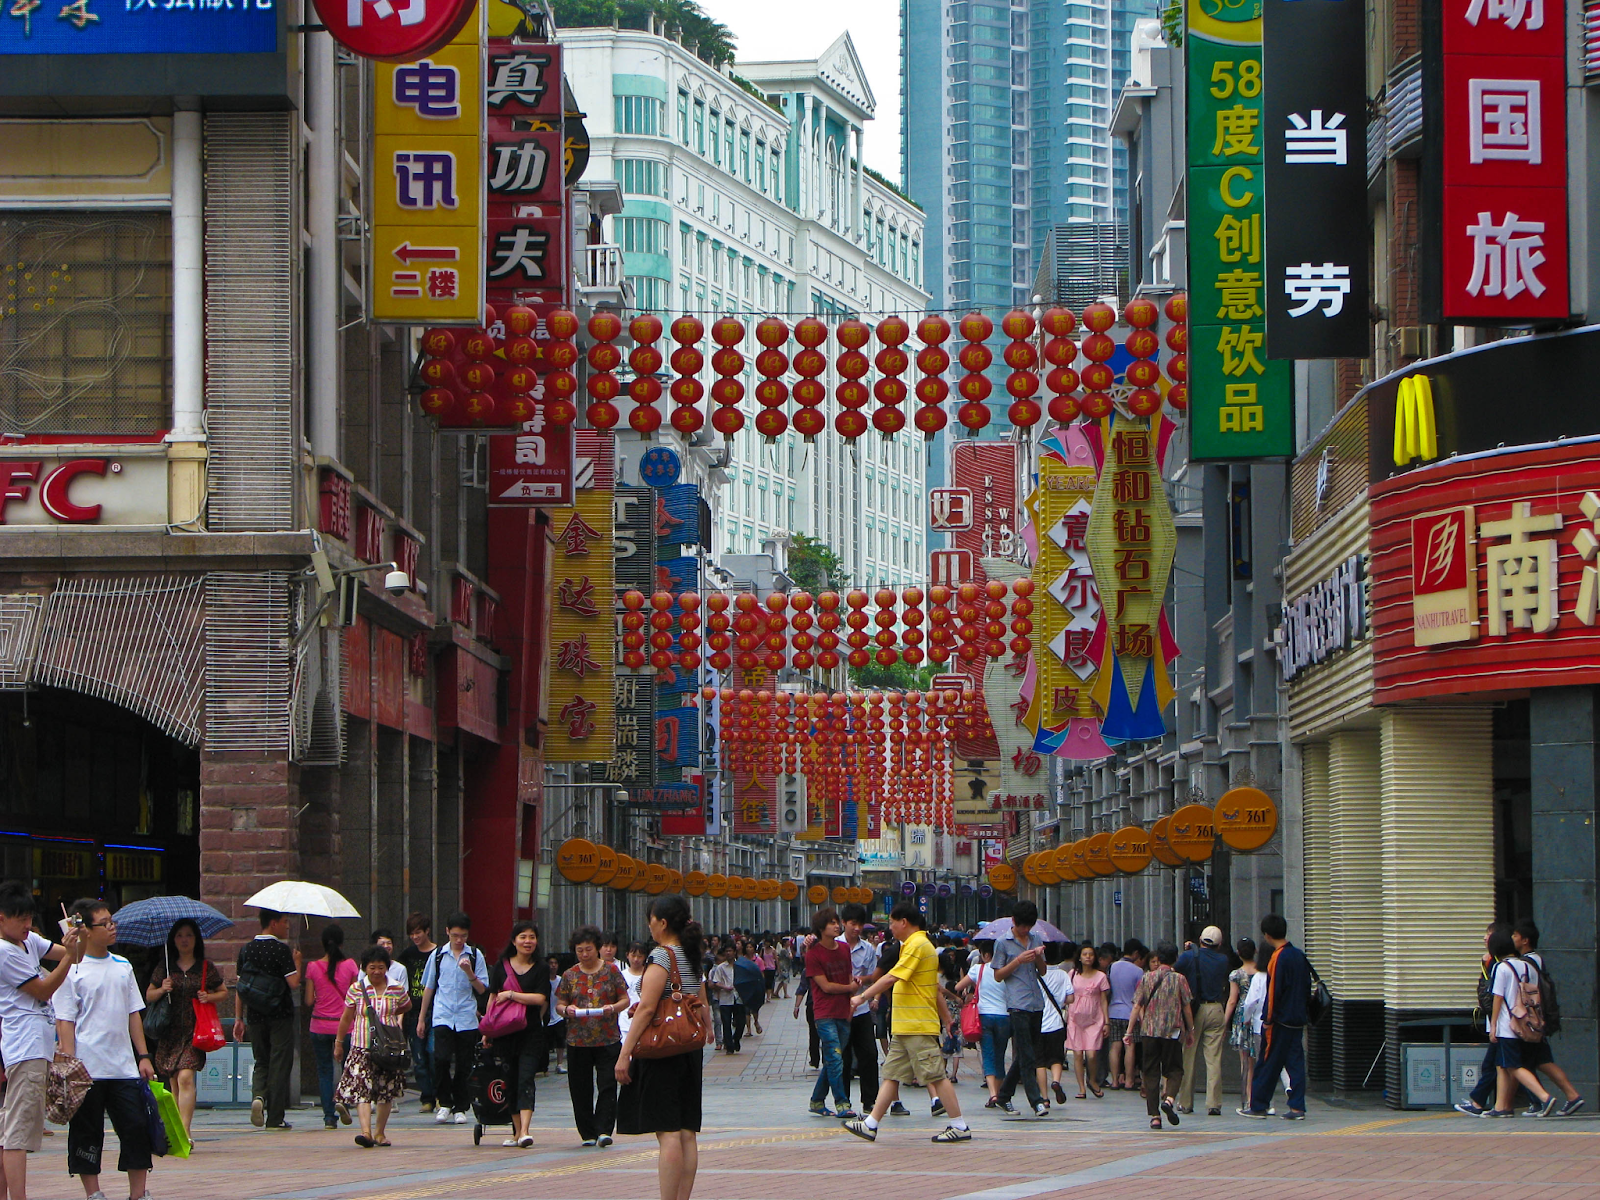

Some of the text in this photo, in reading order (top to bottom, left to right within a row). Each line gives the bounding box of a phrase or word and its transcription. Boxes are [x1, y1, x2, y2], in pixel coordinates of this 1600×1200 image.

[394, 60, 462, 209] 电讯
[487, 54, 549, 279] 真功夫
[391, 269, 459, 299] 二楼
[1209, 60, 1264, 433] 58度C创意饮品
[521, 486, 556, 496] 负一层
[1112, 430, 1154, 659] 恒和钻石广场
[555, 511, 603, 740] 金达珠宝
[1416, 607, 1469, 632] NANHUTRAVEL
[1245, 807, 1271, 824] 361°
